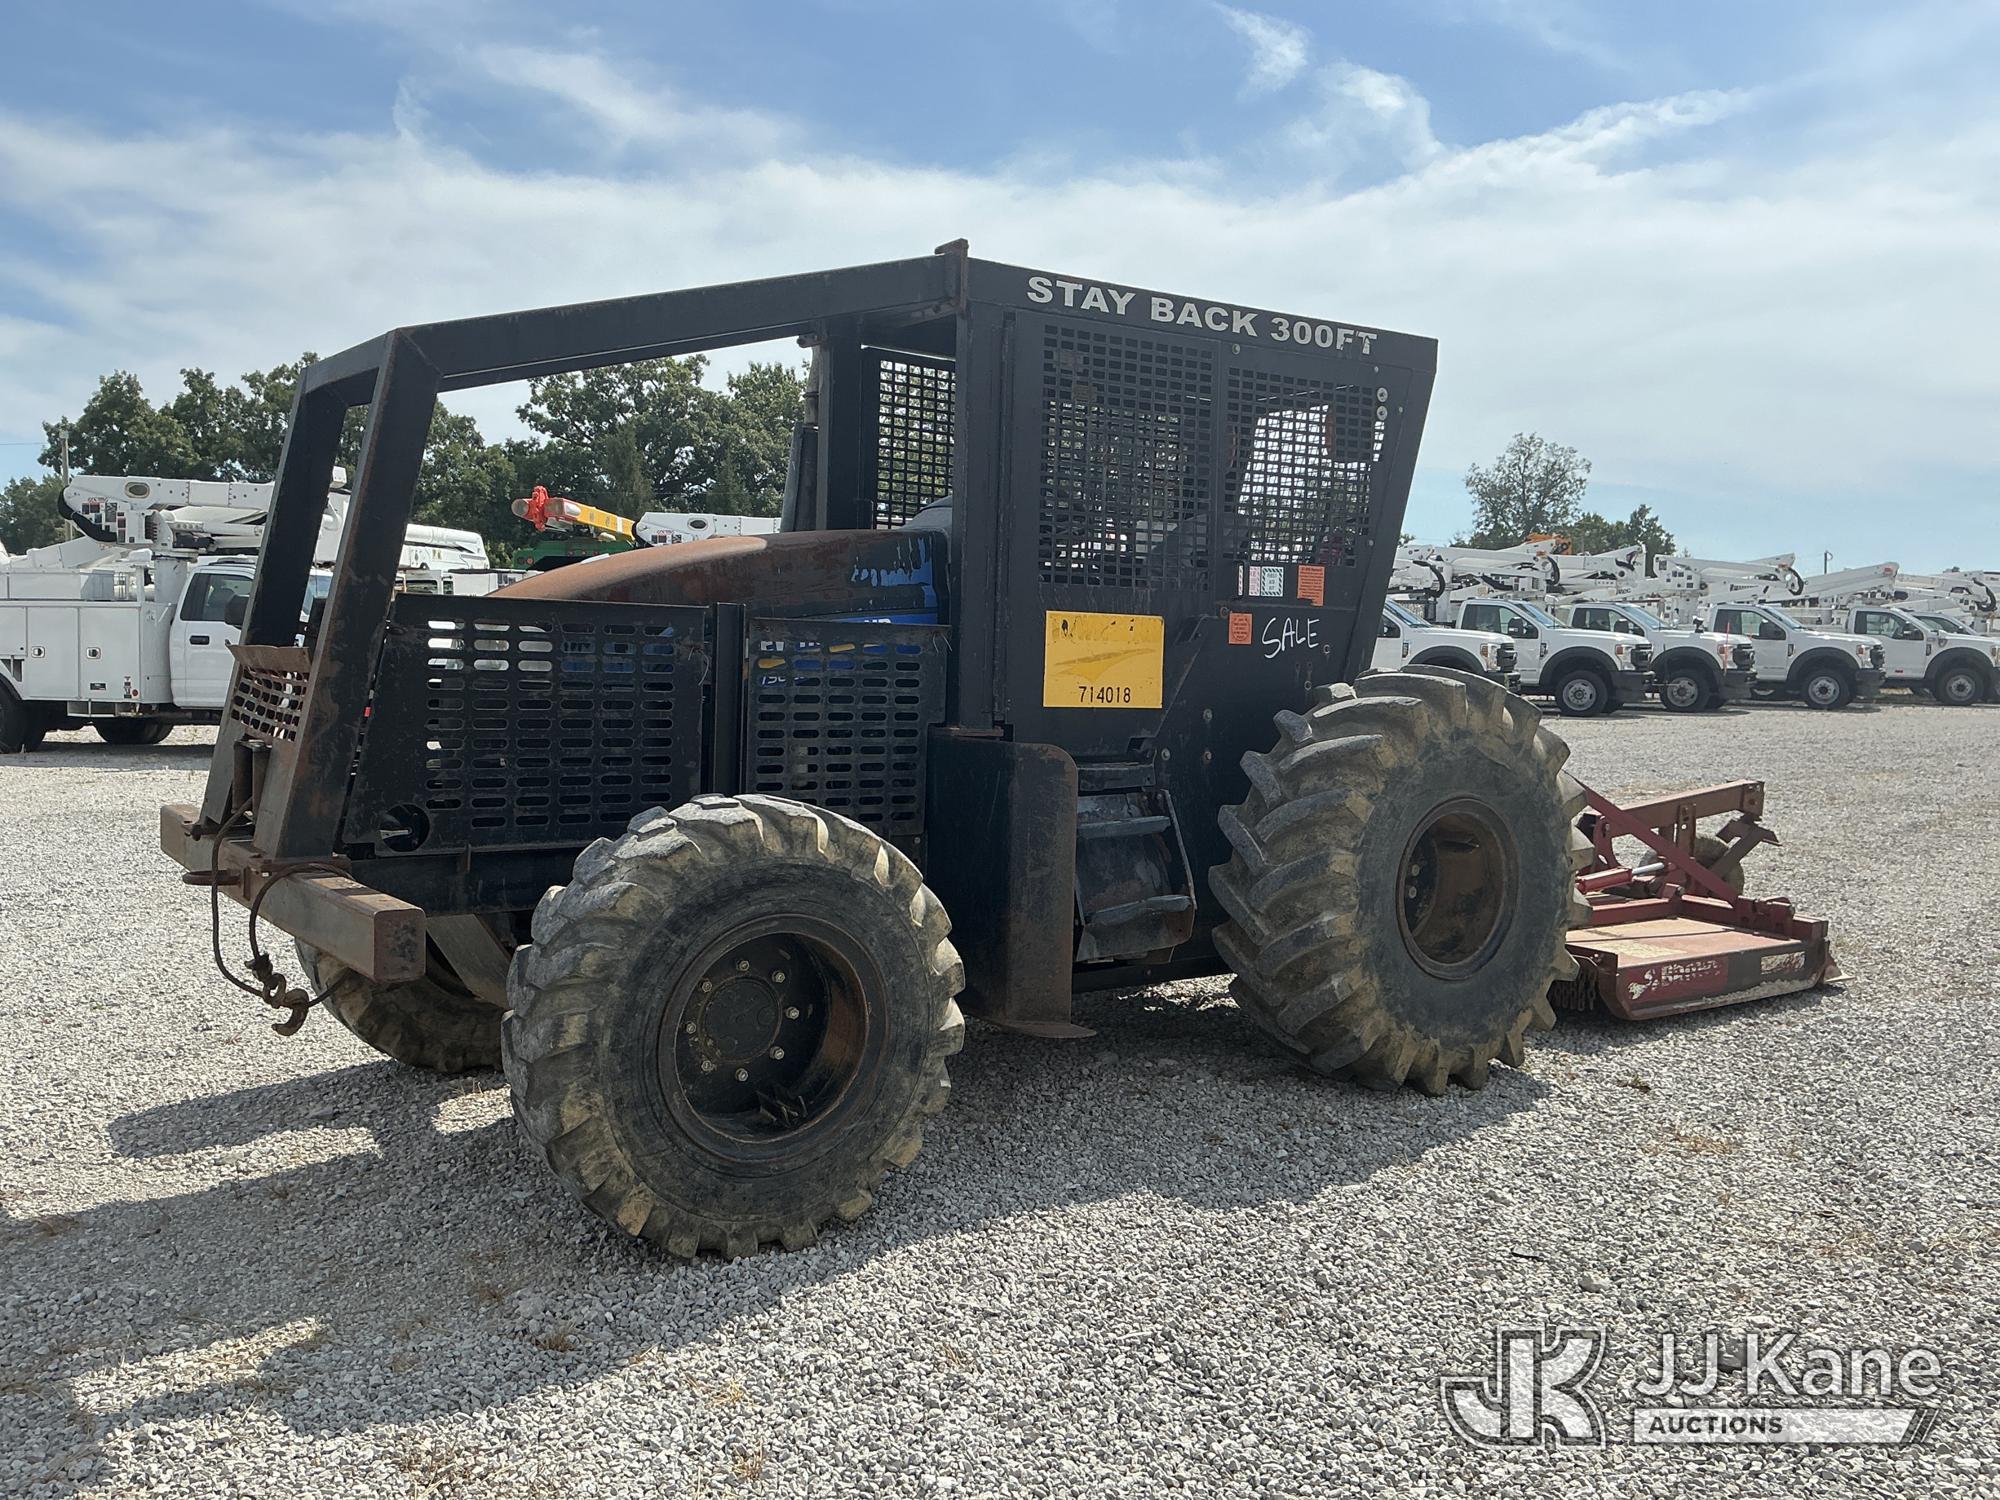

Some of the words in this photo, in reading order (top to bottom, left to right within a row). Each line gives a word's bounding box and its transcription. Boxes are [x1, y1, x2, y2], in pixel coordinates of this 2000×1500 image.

[1026, 276, 1137, 316] STAY
[1150, 296, 1259, 337] BACK
[1270, 317, 1378, 356] 300FT
[1261, 617, 1321, 659] SALE
[1078, 686, 1132, 704] 714018
